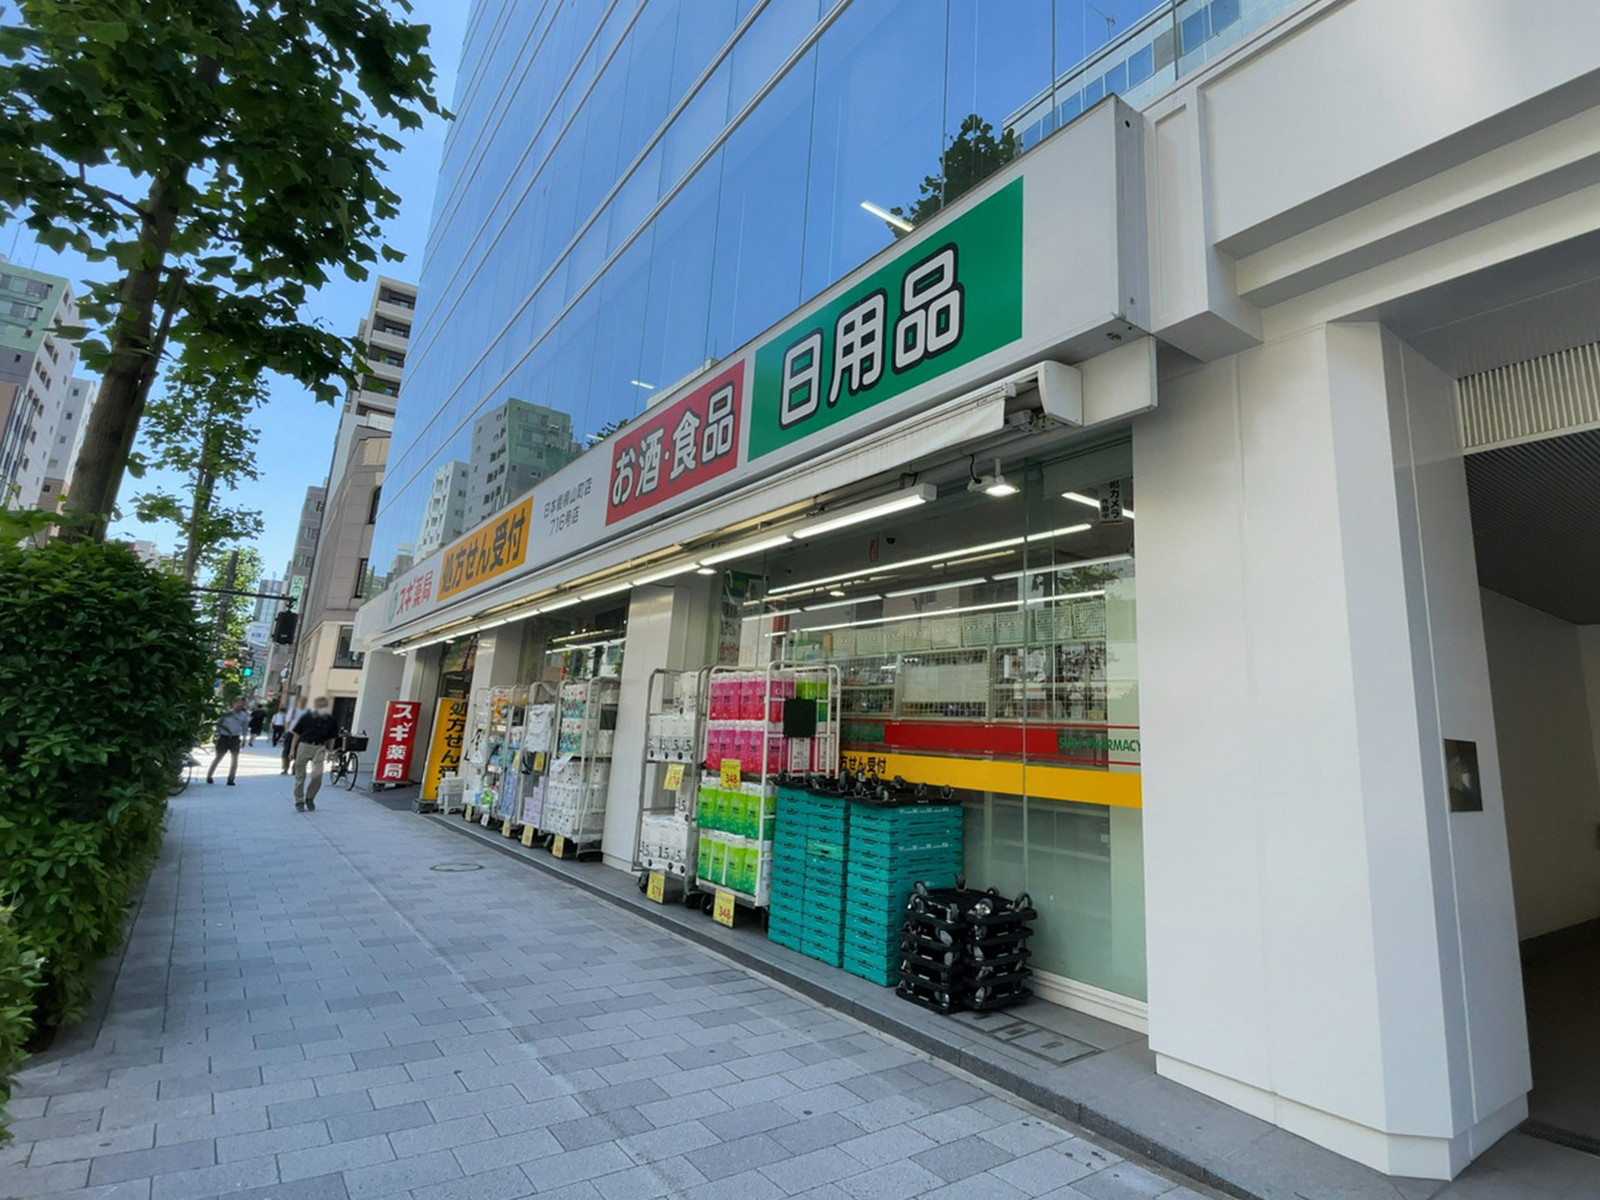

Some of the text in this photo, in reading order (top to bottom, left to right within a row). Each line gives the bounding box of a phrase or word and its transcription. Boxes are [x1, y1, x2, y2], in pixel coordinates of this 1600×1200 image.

[780, 246, 962, 428] 日用品
[611, 383, 734, 506] お酒・食品
[397, 569, 433, 615] スギ薬局
[441, 507, 526, 594] 処方せん受付
[382, 703, 413, 779] スギ薬局
